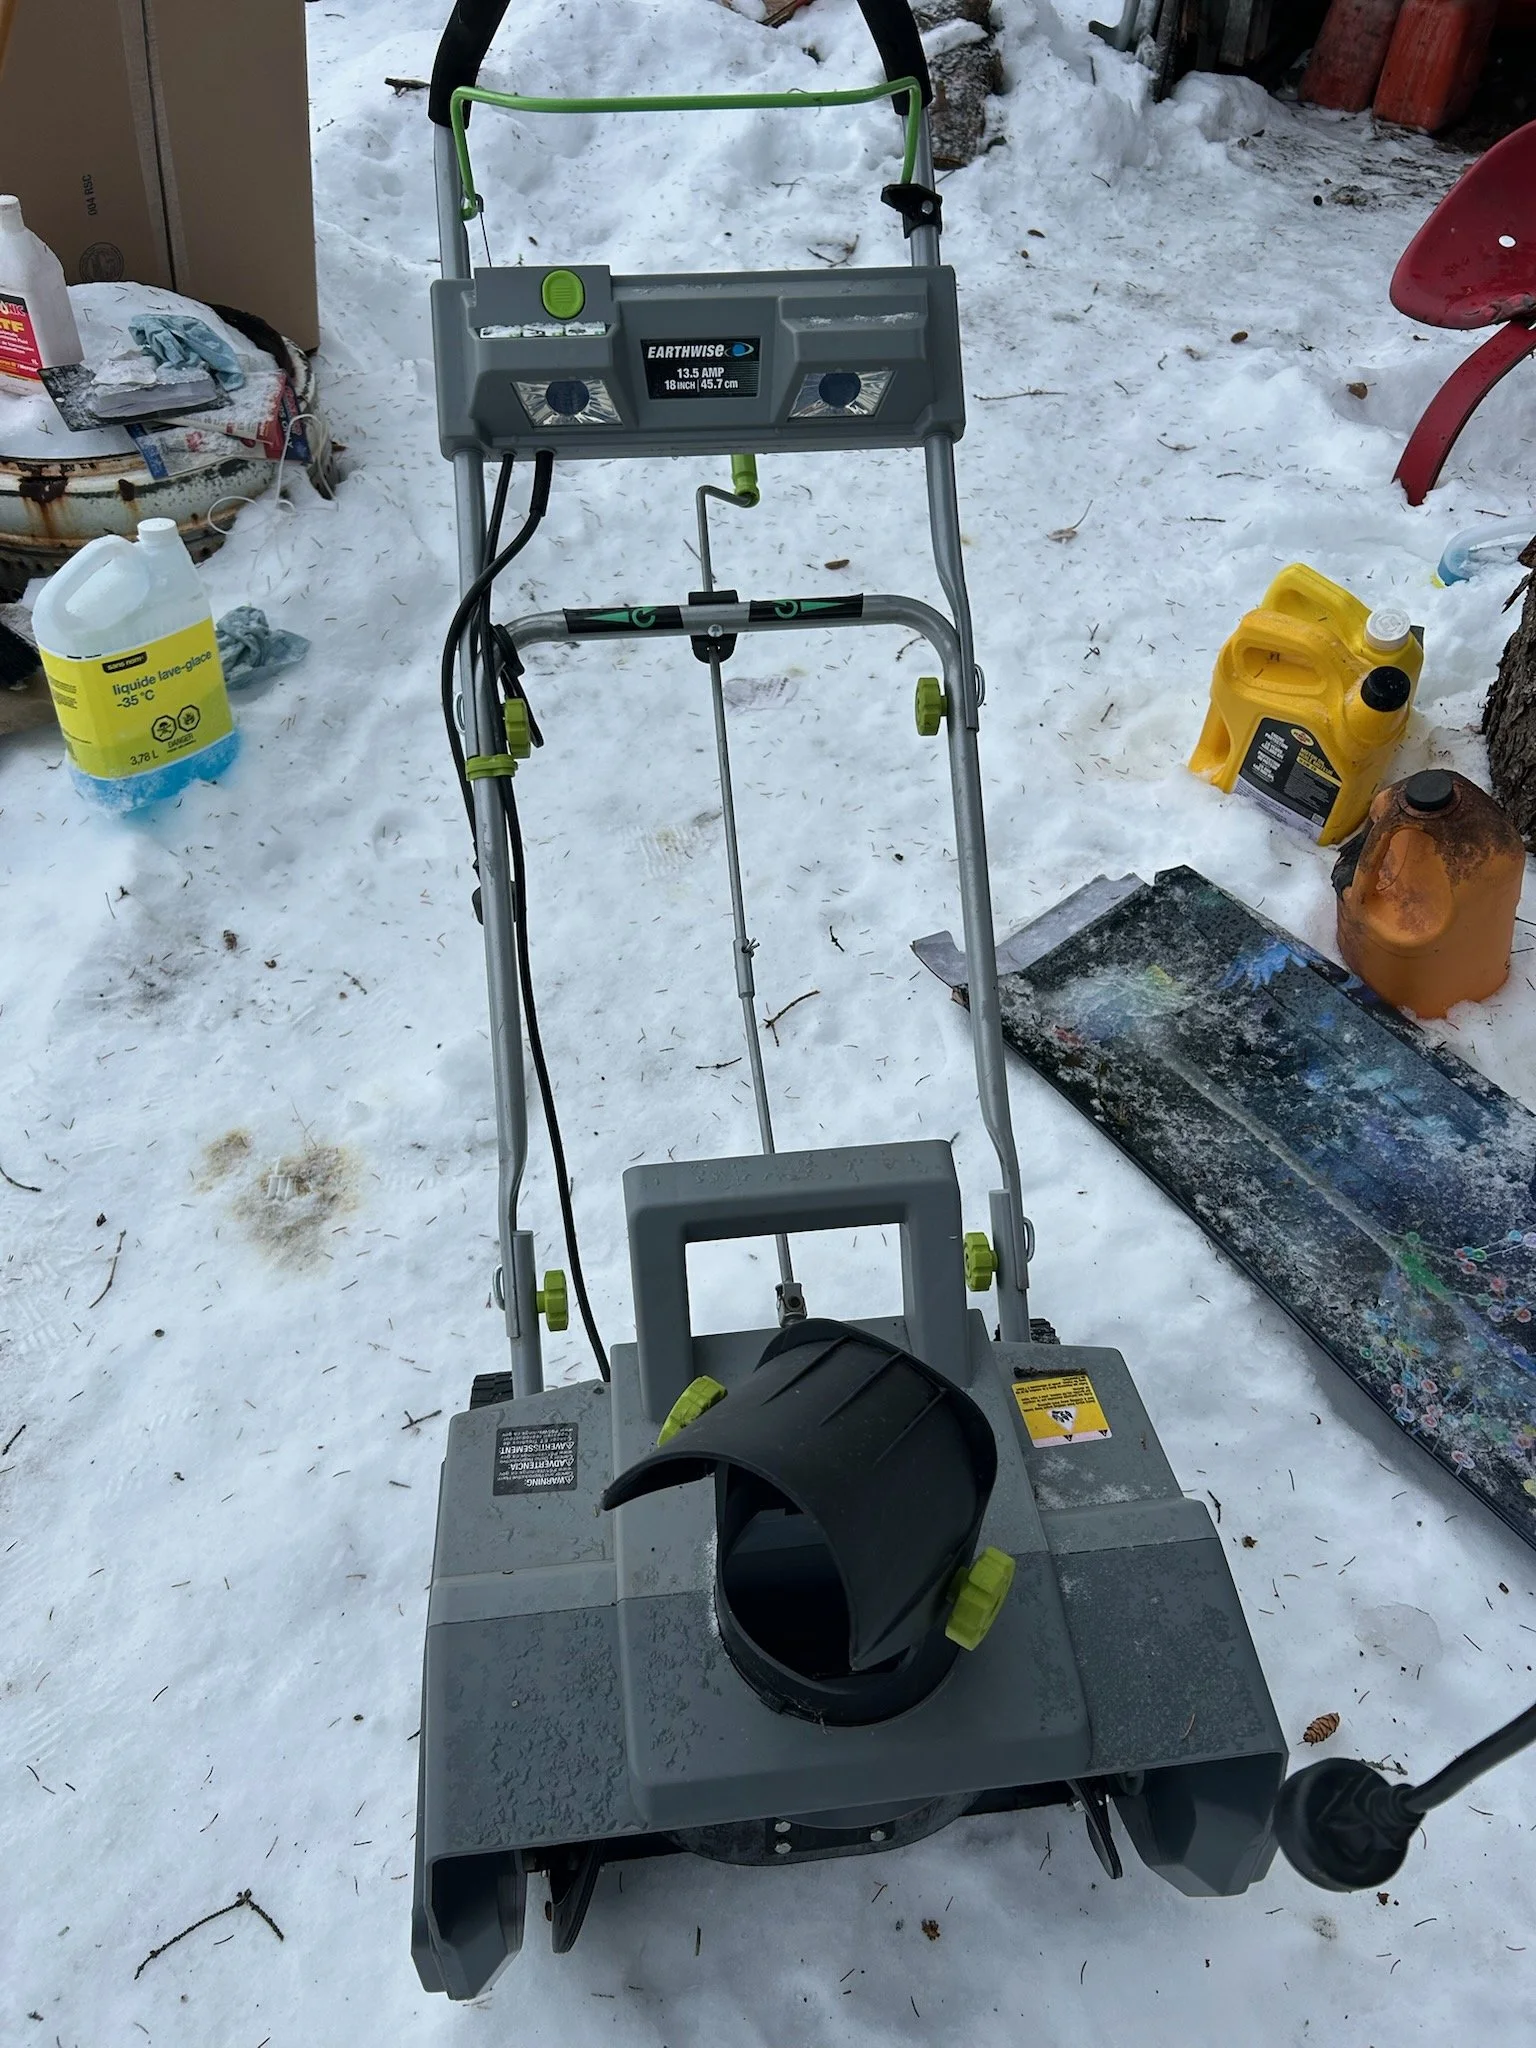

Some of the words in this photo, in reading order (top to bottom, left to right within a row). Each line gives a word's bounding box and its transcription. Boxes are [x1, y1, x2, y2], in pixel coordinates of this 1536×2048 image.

[82, 174, 94, 196] RSC
[677, 368, 700, 378] 13.5
[701, 367, 725, 378] AMP
[664, 380, 677, 390] 18
[677, 381, 696, 390] INCH
[700, 379, 723, 389] 45.7
[724, 380, 739, 388] cm
[112, 676, 157, 696] liquide
[158, 650, 212, 682] lave-glace
[117, 694, 139, 708] -35
[140, 689, 155, 701] °C
[130, 755, 151, 766] 3,78
[152, 750, 160, 760] L
[498, 1442, 566, 1455] AVERTISSEMENT:
[508, 1459, 566, 1470] ADVERTENCIA:
[523, 1476, 565, 1487] WARNING:
